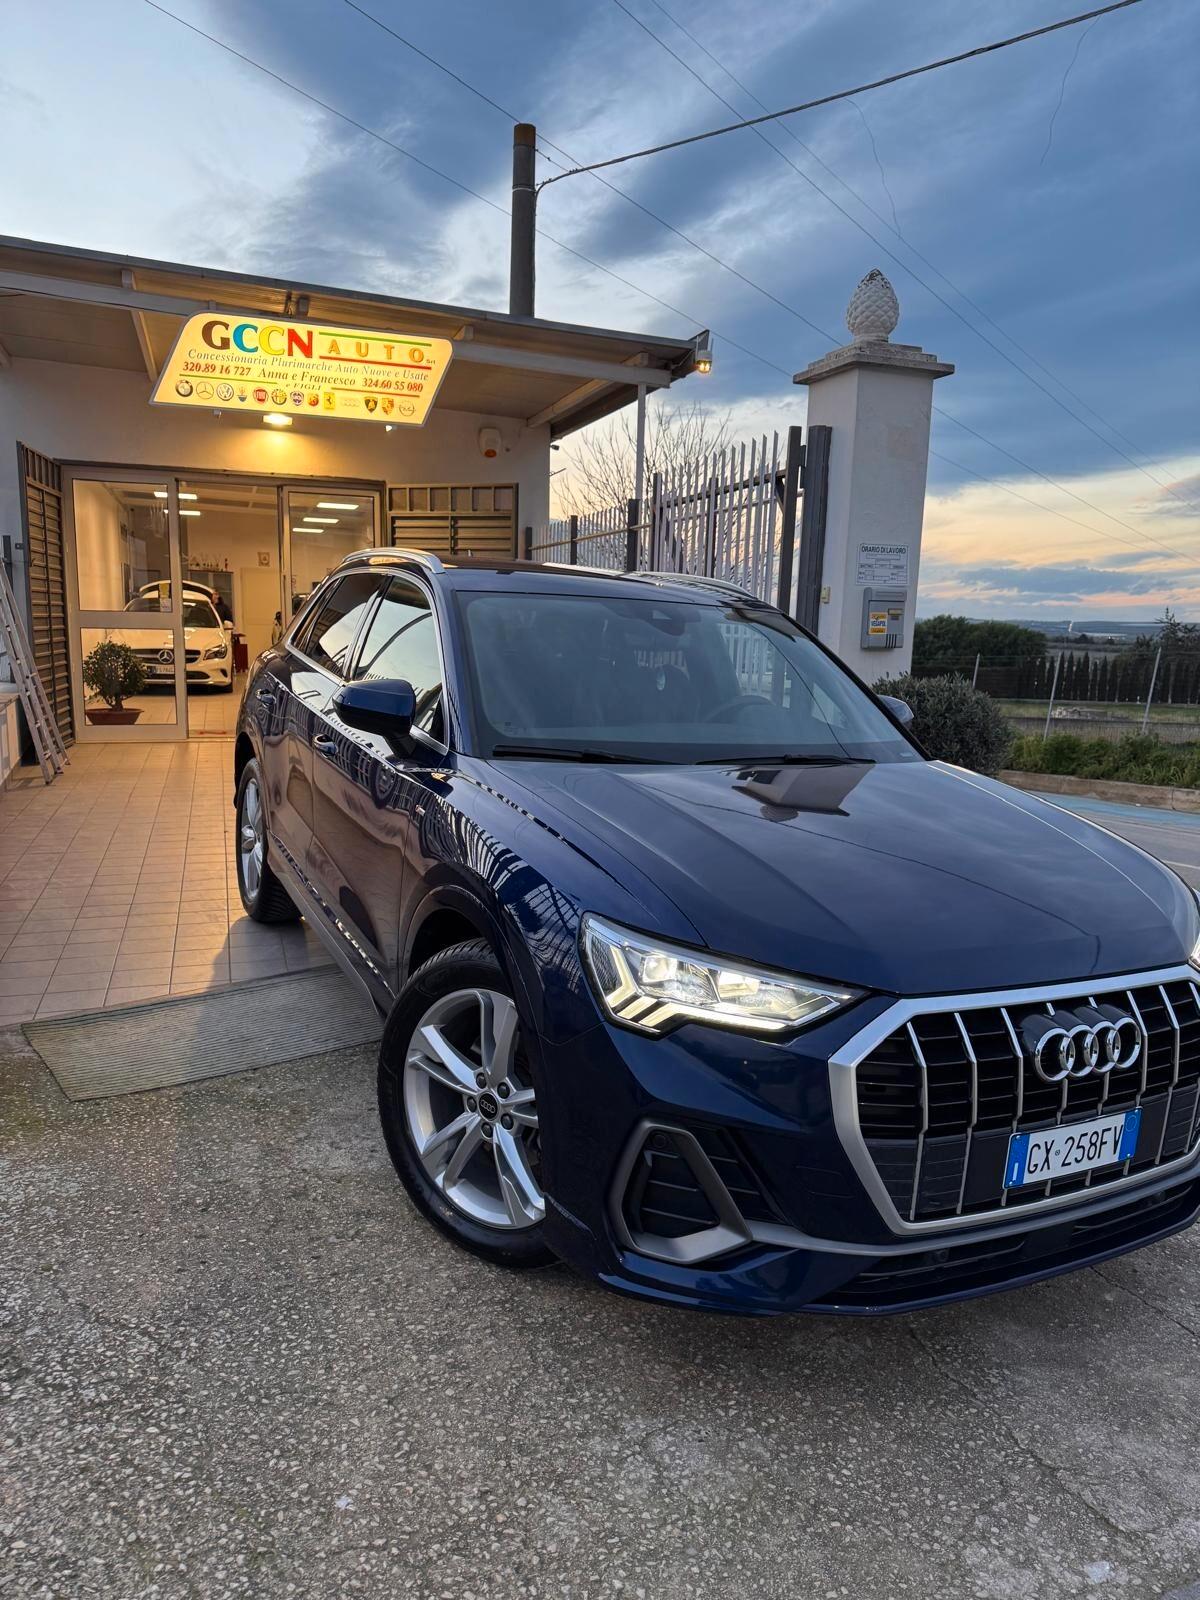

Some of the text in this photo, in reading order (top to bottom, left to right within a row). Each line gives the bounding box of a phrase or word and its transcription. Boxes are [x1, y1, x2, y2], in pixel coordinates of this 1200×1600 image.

[202, 320, 313, 358] GCCN
[328, 339, 425, 363] AUTO
[188, 348, 268, 366] Concessionaria
[271, 356, 333, 371] Plurimarche
[335, 363, 358, 374] Auto
[361, 366, 392, 378] Nuove
[403, 370, 429, 381] Usate
[220, 365, 231, 374] 16
[234, 366, 251, 377] 727
[257, 367, 288, 380] Anna
[301, 371, 356, 386] Francesco
[394, 383, 405, 392] 55
[407, 383, 423, 393] 080
[294, 383, 321, 391] FIGLI
[861, 545, 907, 555] ORARIO DI LAVORO
[1027, 1140, 1055, 1174] GX
[1061, 1125, 1124, 1167] 258FV
